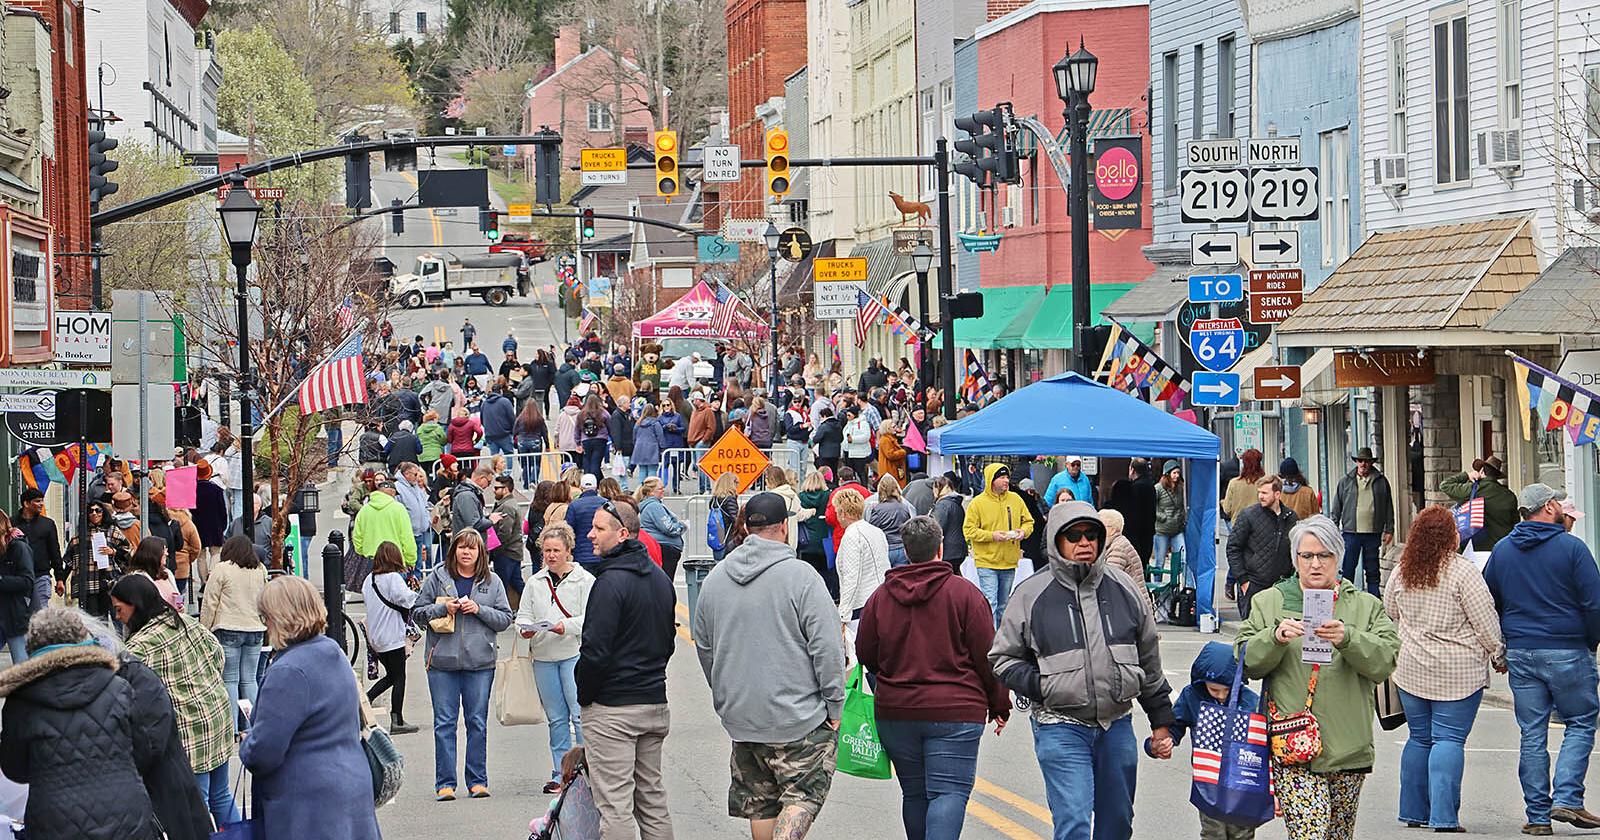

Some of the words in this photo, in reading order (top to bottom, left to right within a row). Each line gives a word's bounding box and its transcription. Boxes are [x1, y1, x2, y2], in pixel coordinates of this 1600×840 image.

[1190, 145, 1239, 162] SOUTH
[1249, 143, 1298, 161] NORTH
[1096, 158, 1137, 179] bella
[259, 189, 283, 198] STREET
[1191, 180, 1238, 209] 219
[1261, 178, 1308, 208] 219
[1253, 272, 1263, 280] WV
[1266, 271, 1299, 280] MOUNTAIN
[1200, 280, 1231, 296] TO
[1266, 281, 1287, 290] RIDES
[1261, 297, 1293, 307] SENECA
[818, 308, 831, 316] USE
[1261, 308, 1293, 319] SKYWAY
[1197, 321, 1236, 330] INTERSTATE
[1198, 335, 1237, 361] 64
[65, 351, 93, 359] Broker
[1341, 351, 1428, 376] FOXFIRE
[21, 371, 48, 379] QUEST
[49, 371, 79, 379] REALTY
[1126, 353, 1169, 391] OPEN
[22, 431, 55, 439] STREET
[718, 448, 751, 459] ROAD
[711, 463, 758, 475] CLOSED
[851, 744, 880, 759] VALLEY
